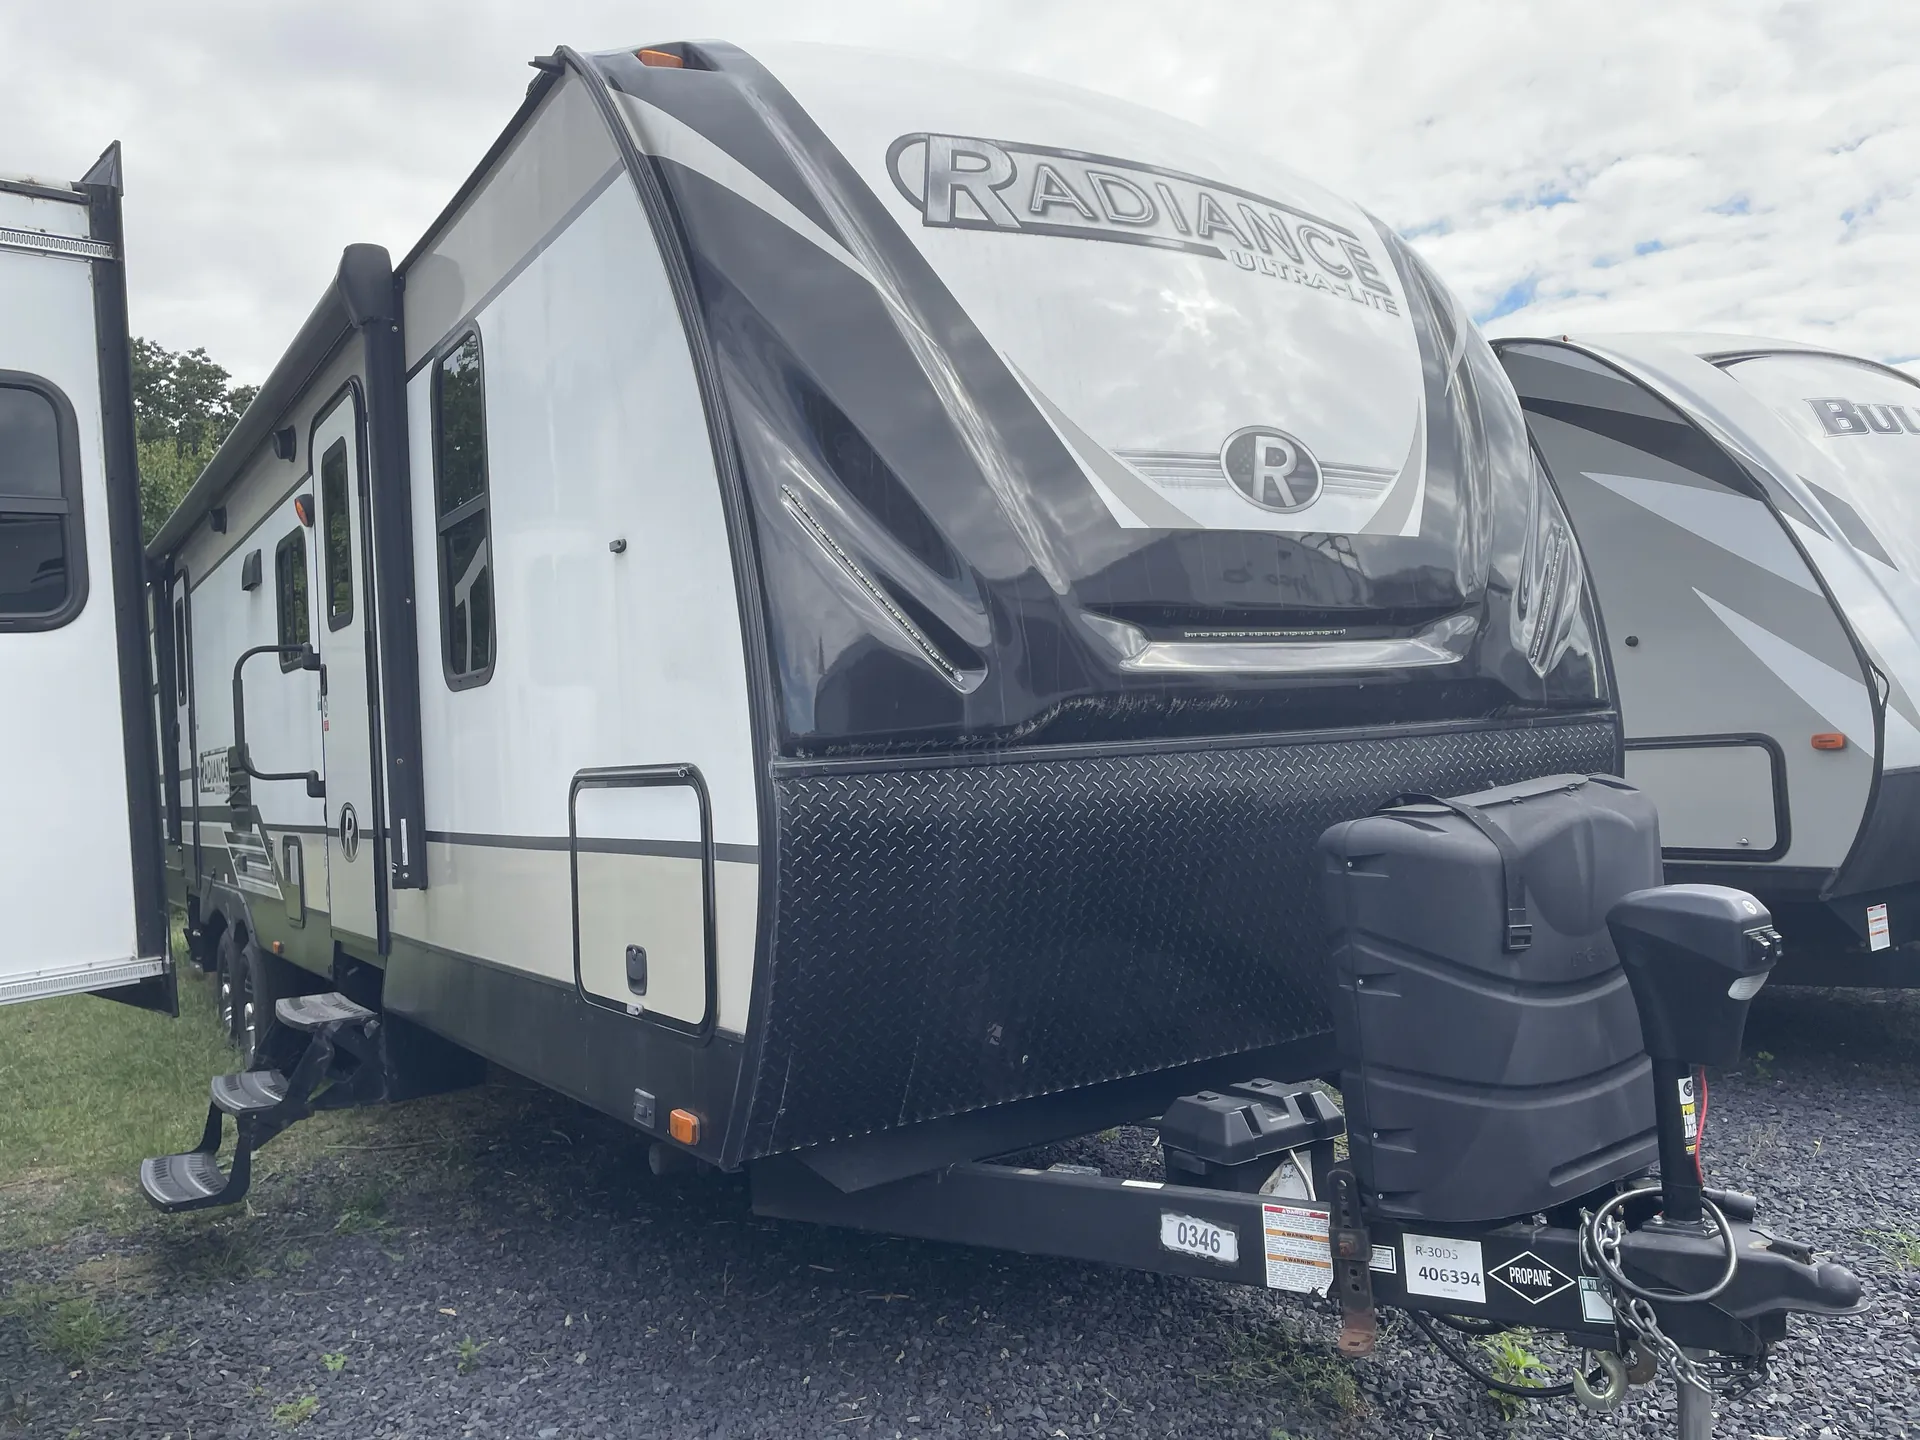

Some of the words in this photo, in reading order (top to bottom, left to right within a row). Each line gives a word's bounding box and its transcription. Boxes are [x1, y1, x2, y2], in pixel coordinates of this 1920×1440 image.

[922, 134, 1393, 297] RADIANCE
[1230, 250, 1400, 317] ULTRA-LITE
[1802, 396, 1920, 438] BUL
[1251, 435, 1297, 508] R
[1177, 1222, 1221, 1253] 0346
[1287, 1232, 1314, 1241] WARNING
[1288, 1256, 1316, 1266] WARNING
[1415, 1245, 1458, 1260] R-30DS
[1418, 1266, 1481, 1287] 406394
[1508, 1266, 1553, 1287] PROPANE
